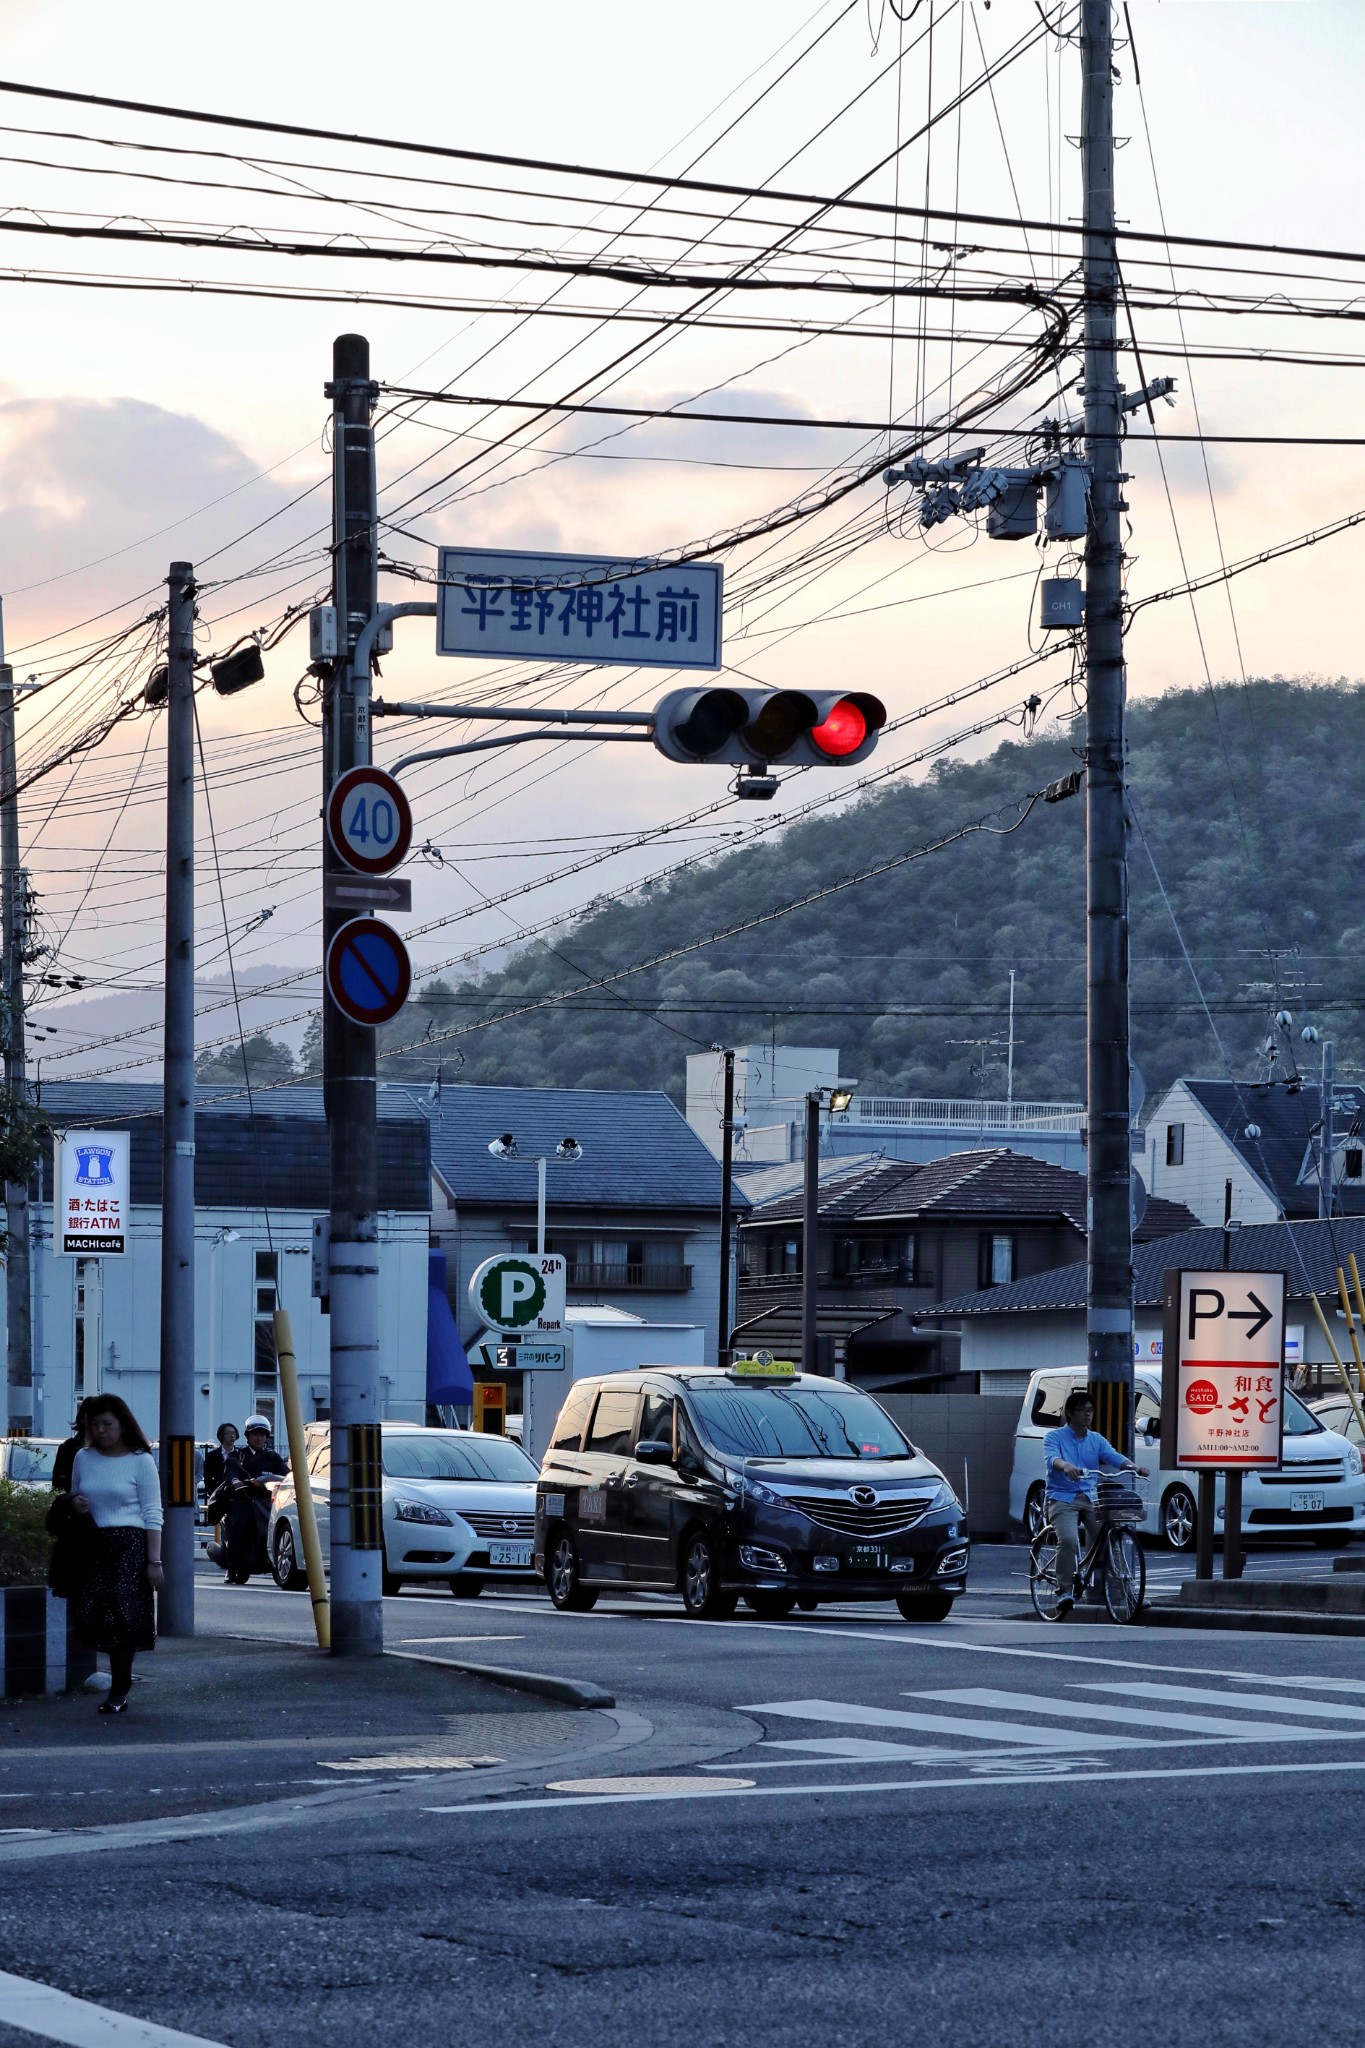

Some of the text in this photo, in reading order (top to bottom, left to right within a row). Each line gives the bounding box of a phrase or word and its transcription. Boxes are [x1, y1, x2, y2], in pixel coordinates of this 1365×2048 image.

[461, 575, 700, 643] 平野神社前
[1051, 601, 1071, 610] CH1
[349, 797, 393, 845] 40
[77, 1148, 112, 1157] LAWSON
[77, 1176, 111, 1185] STATION
[68, 1217, 120, 1229] 銀行ATM
[67, 1239, 121, 1249] MACHI café
[541, 1259, 562, 1275] 24h
[501, 1271, 536, 1318] P
[1188, 1288, 1225, 1340] P
[537, 1317, 561, 1331] Repark
[774, 1364, 794, 1373] Taxi
[1233, 1375, 1273, 1393] 和食
[1189, 1393, 1214, 1402] SATO
[1227, 1396, 1278, 1424] さと
[1207, 1428, 1250, 1437] 平野神社店
[582, 1495, 603, 1514] TAXI
[499, 1552, 527, 1564] 25-11
